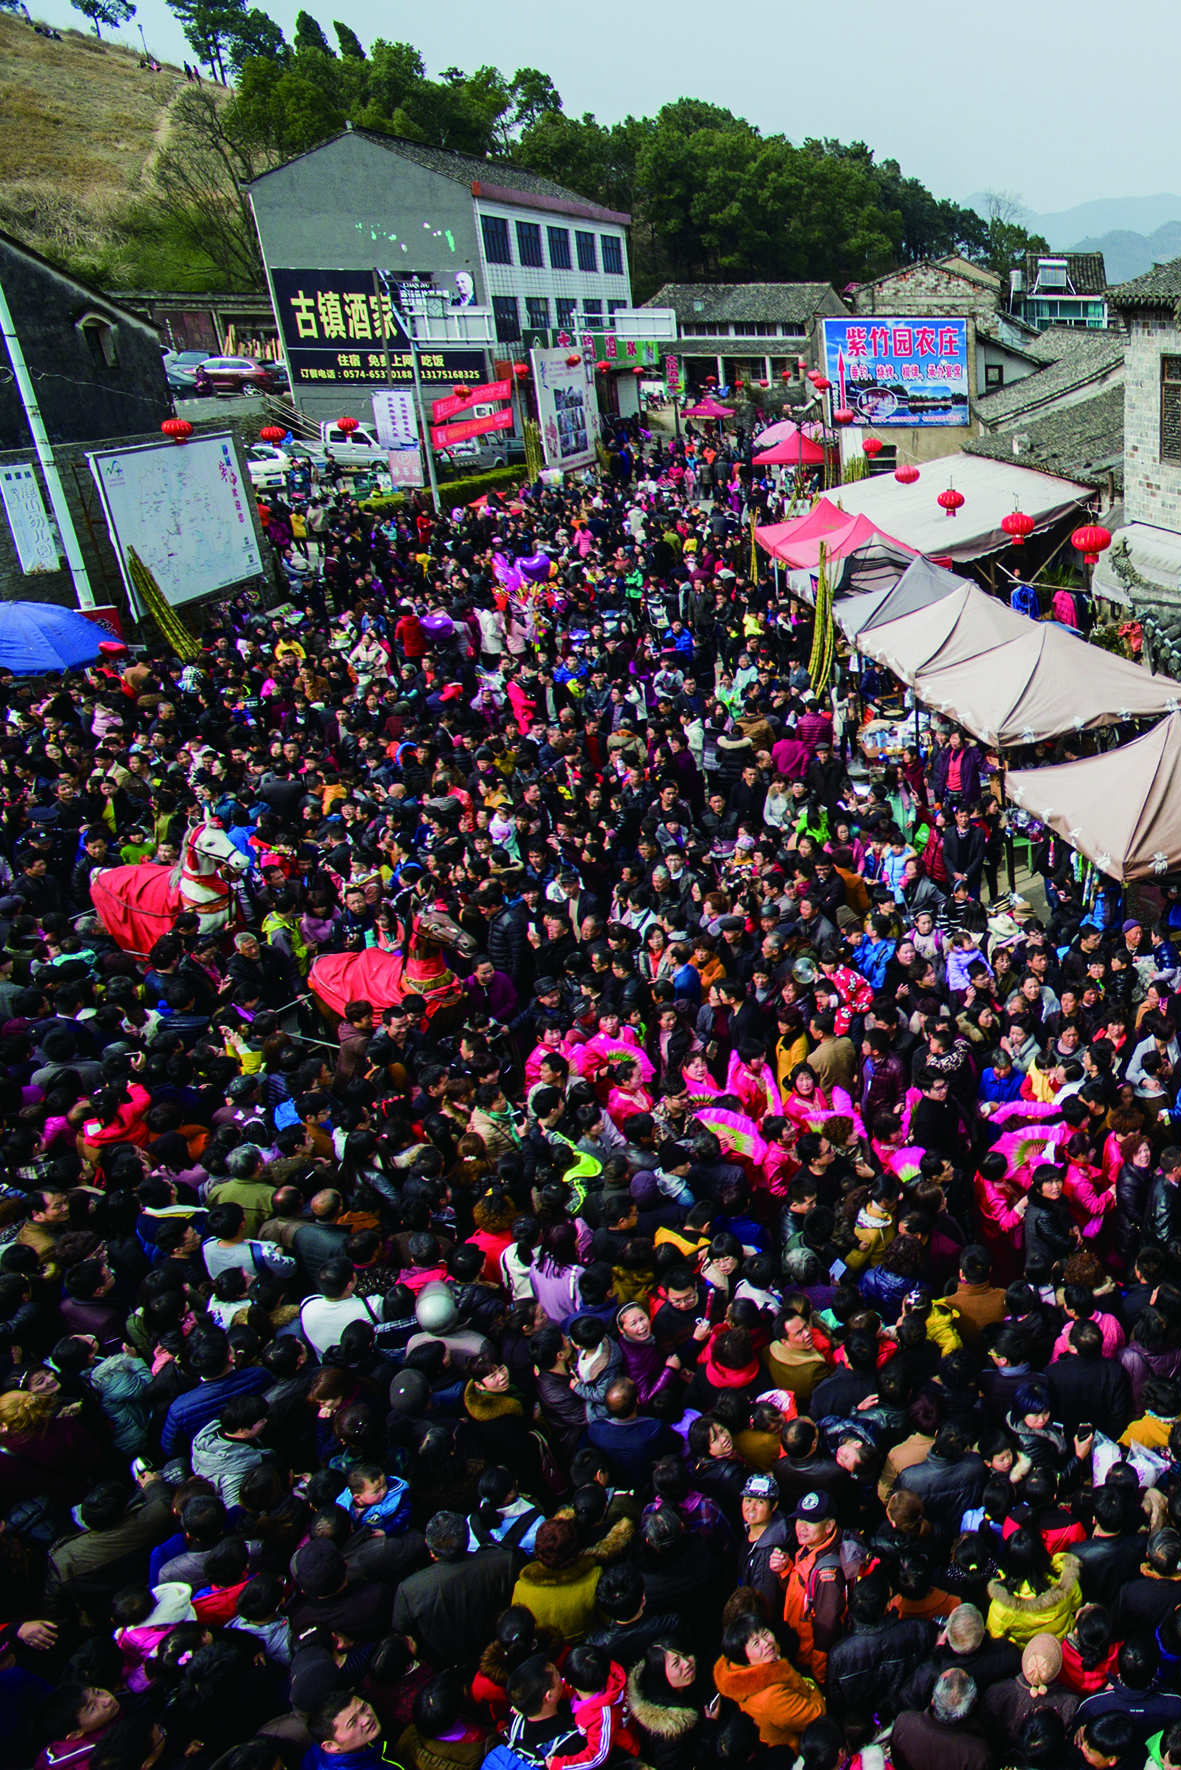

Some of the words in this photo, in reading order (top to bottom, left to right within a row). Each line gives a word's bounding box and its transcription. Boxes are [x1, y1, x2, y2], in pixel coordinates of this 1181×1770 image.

[290, 289, 397, 340] 古镇酒家
[846, 326, 959, 357] 紫竹园农庄
[337, 354, 361, 367] 住宿
[368, 354, 413, 367] 免费上网
[421, 355, 445, 367] 吃饭
[421, 370, 480, 379] 13175168325
[392, 466, 420, 477] 停车场
